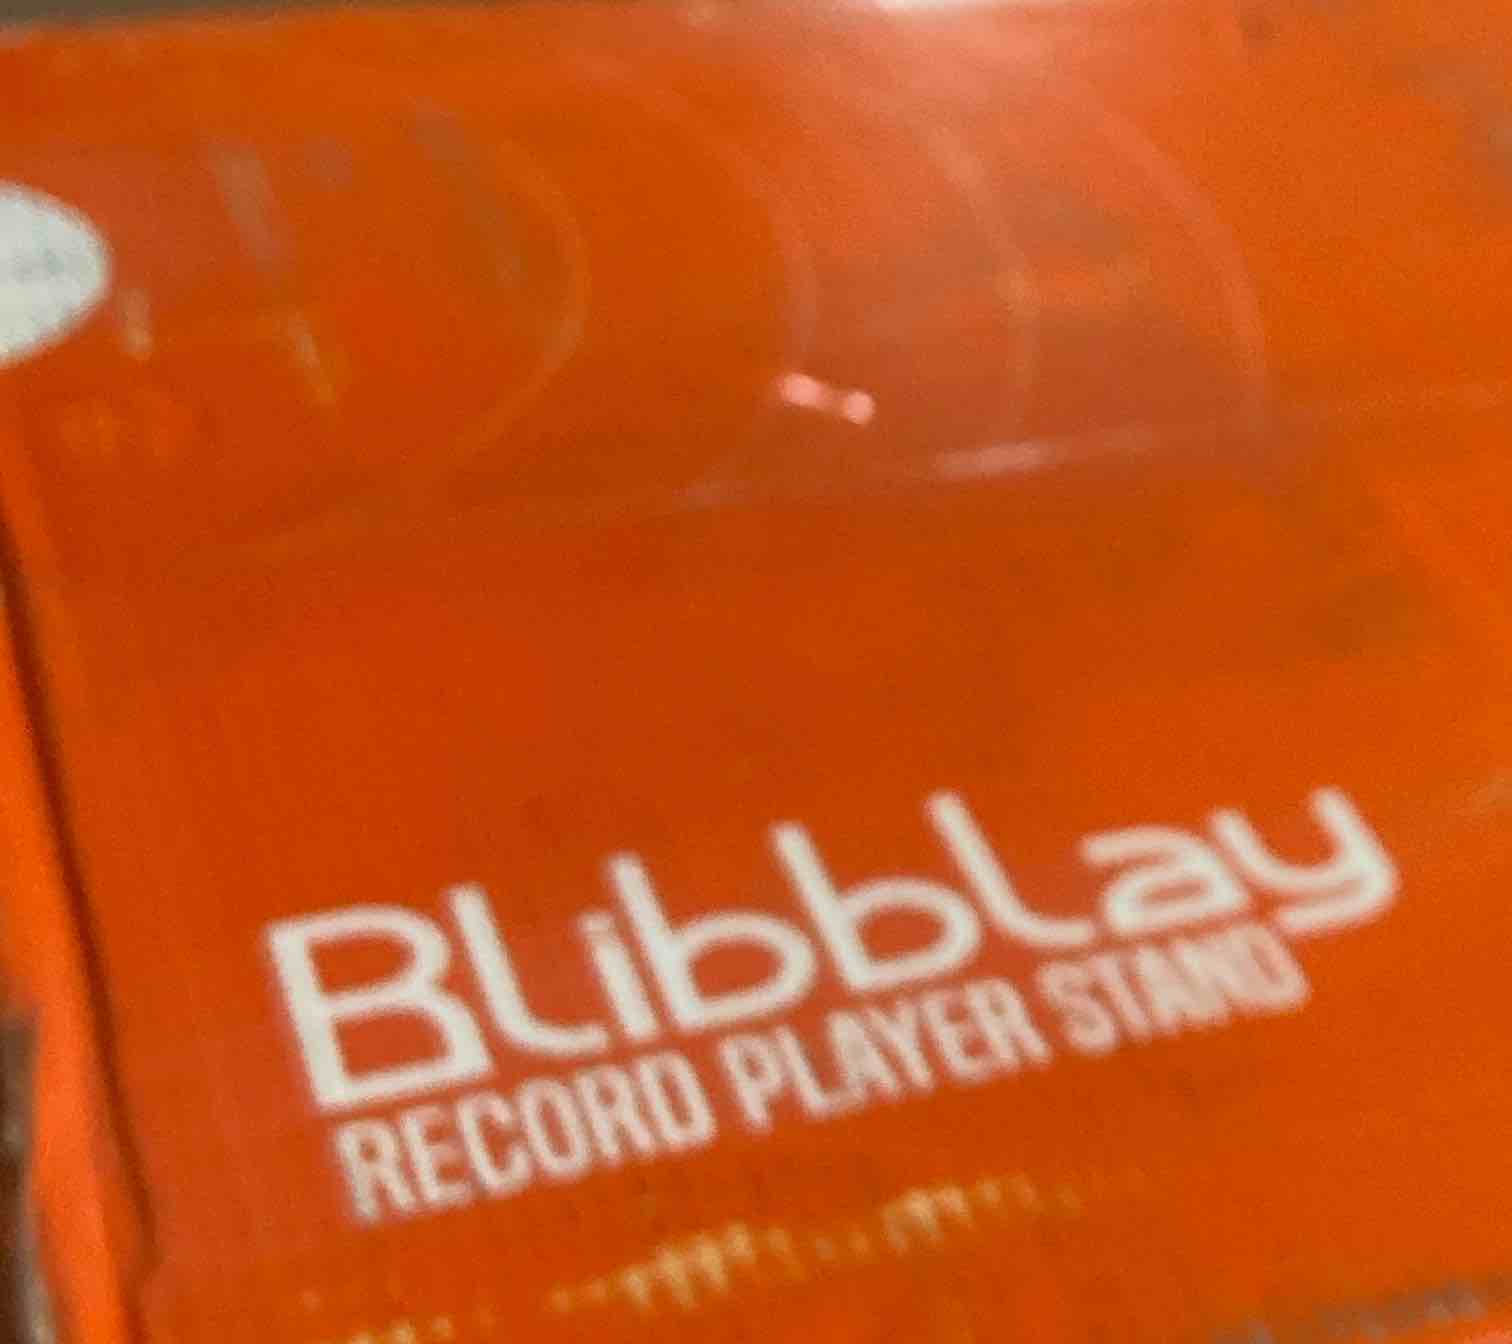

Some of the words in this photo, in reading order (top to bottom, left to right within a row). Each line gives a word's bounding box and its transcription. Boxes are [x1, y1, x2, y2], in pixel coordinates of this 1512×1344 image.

[334, 1049, 716, 1224] RECORD
[728, 978, 1050, 1132] PLAYER
[1041, 924, 1309, 1054] STAND
